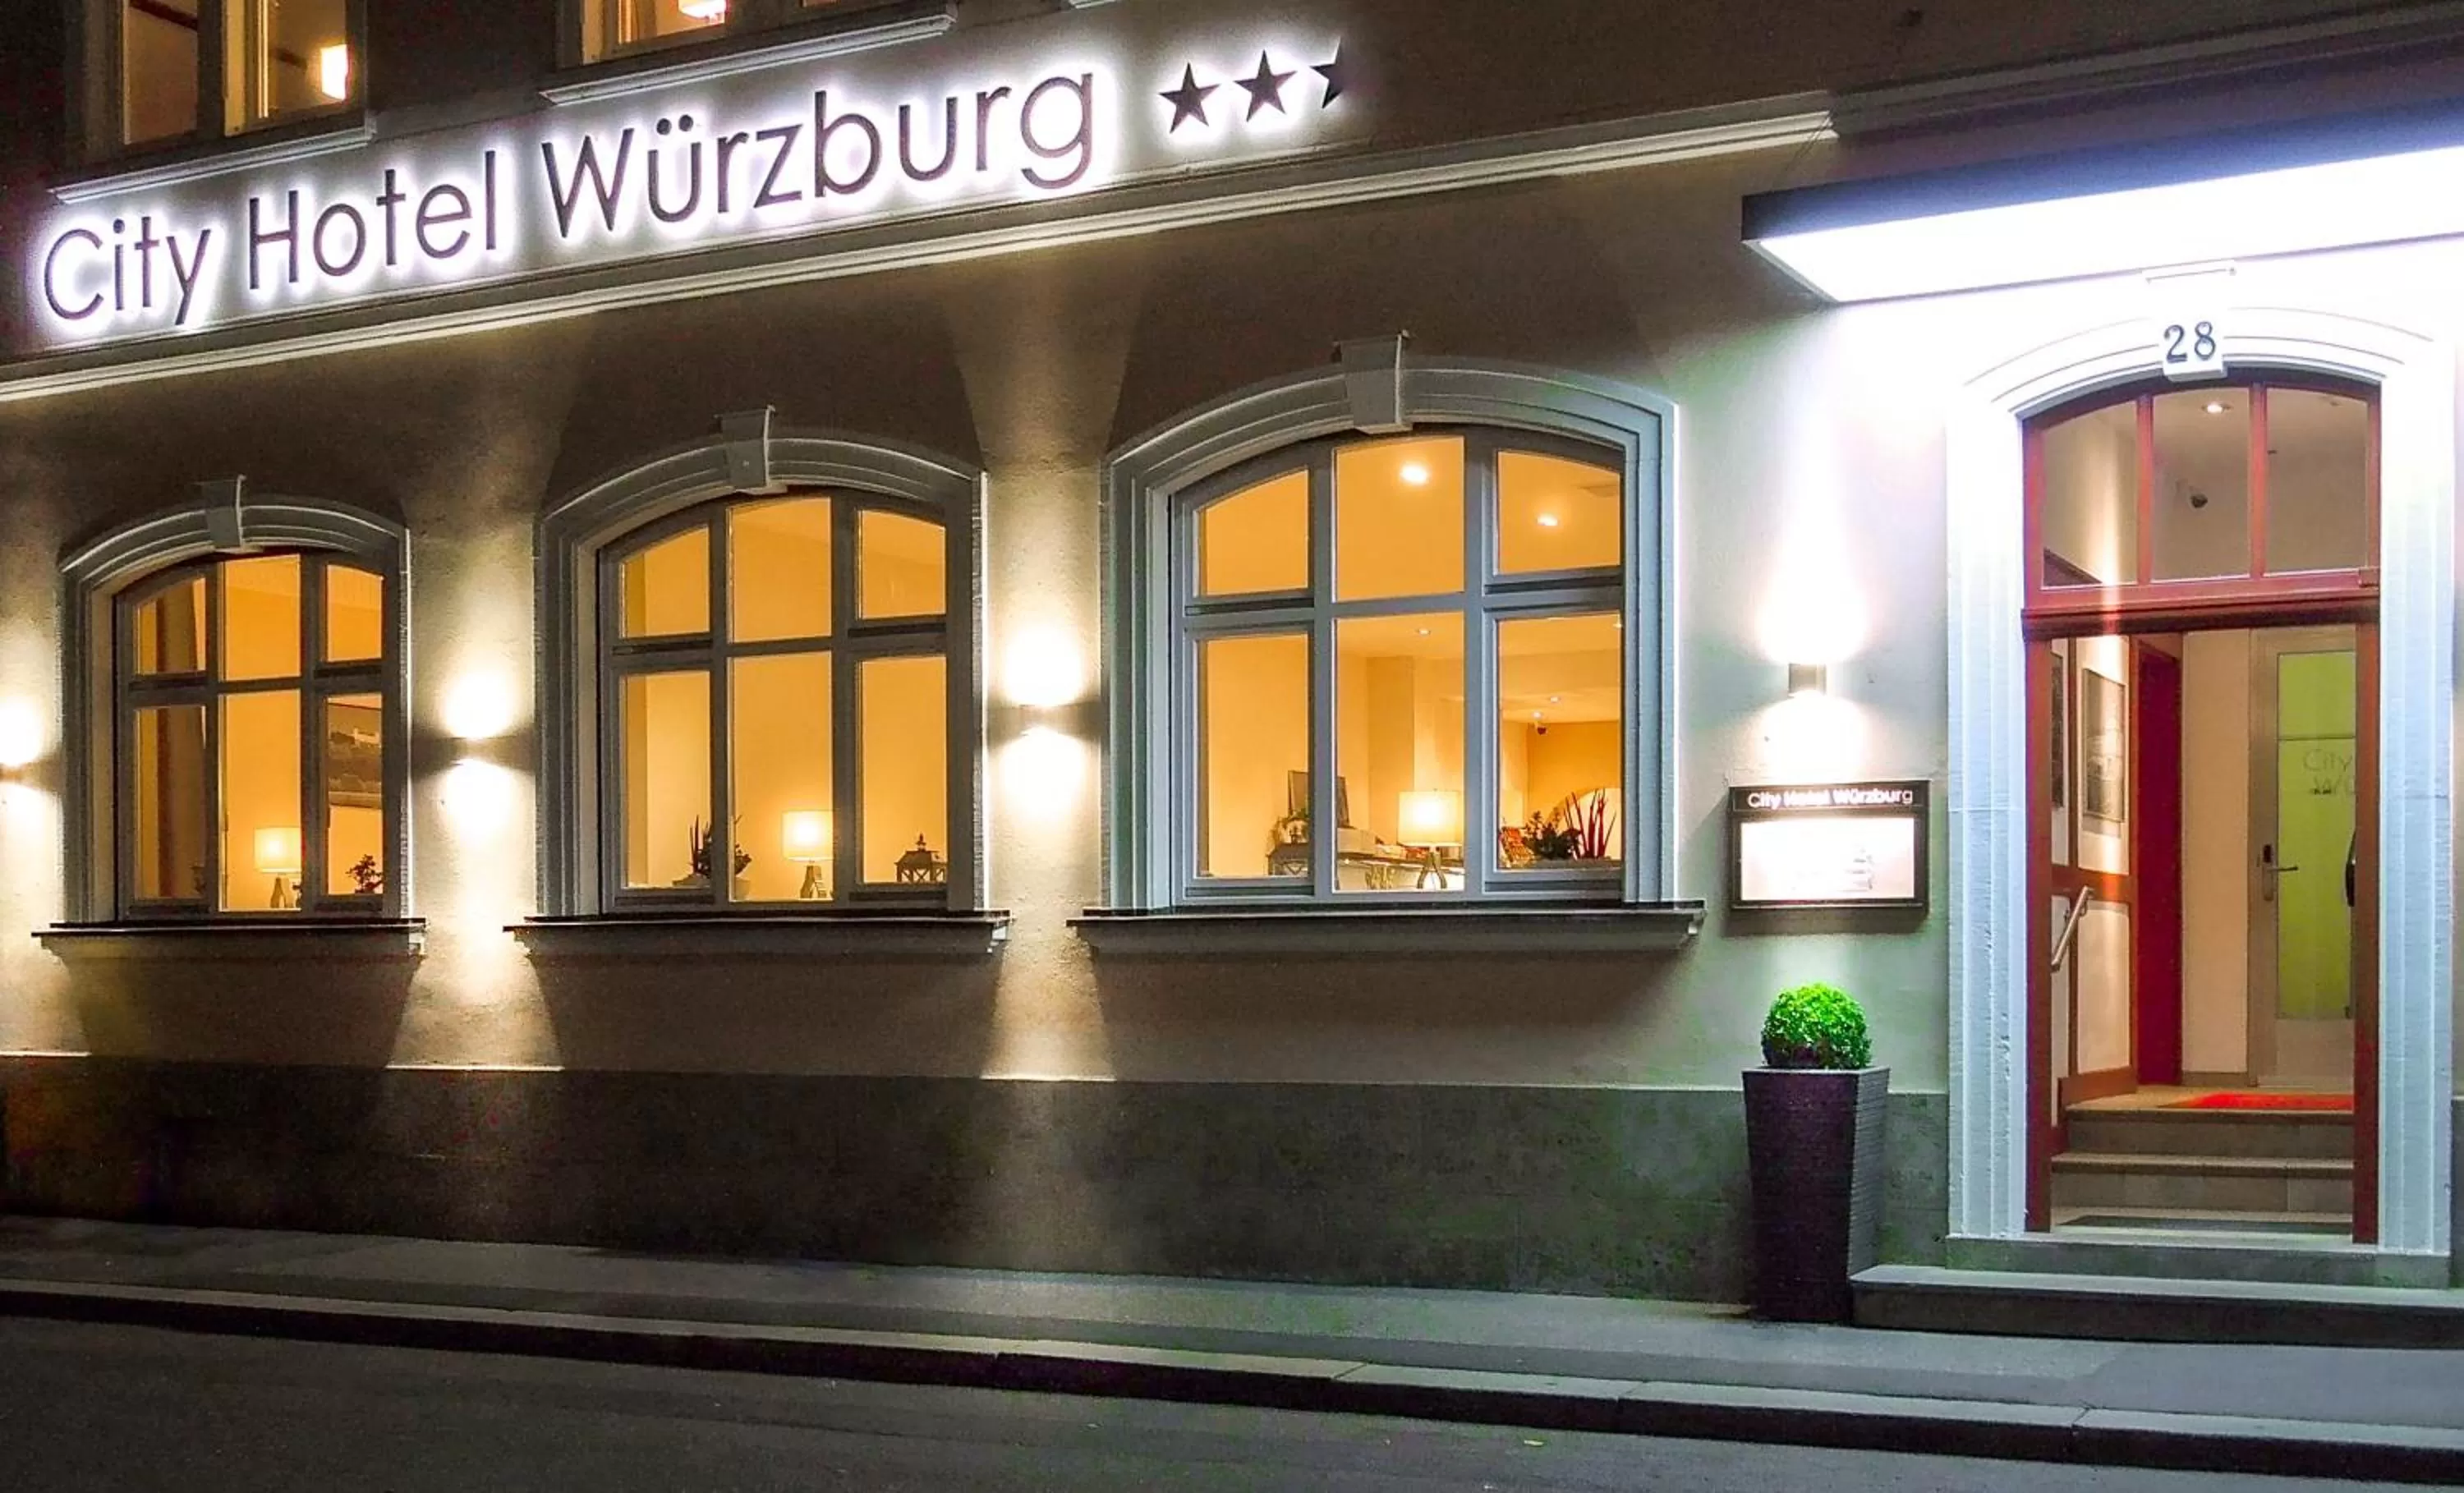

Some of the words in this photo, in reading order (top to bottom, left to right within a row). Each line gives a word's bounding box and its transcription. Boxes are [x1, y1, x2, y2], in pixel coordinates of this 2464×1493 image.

[44, 215, 211, 326] City
[248, 149, 497, 291] Hotel
[540, 71, 1094, 239] Würzburg
[2163, 321, 2216, 364] 28
[1747, 792, 1781, 810] City
